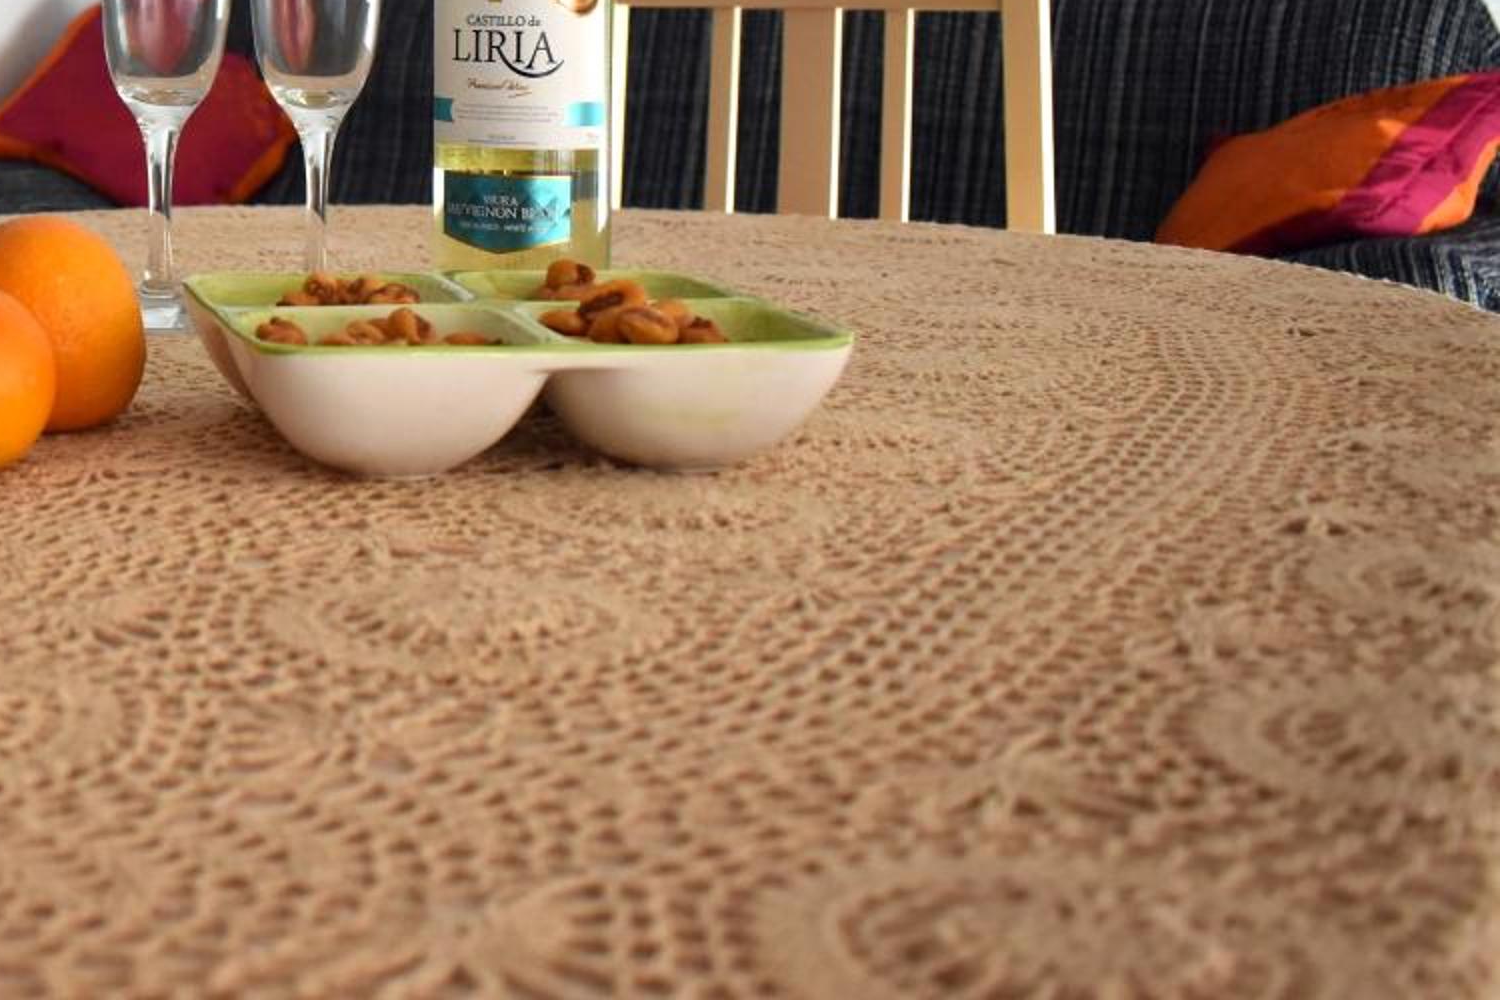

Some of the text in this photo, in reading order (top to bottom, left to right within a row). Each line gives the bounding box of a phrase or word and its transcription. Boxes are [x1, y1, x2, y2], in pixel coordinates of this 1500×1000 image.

[467, 14, 541, 27] CASTILLO de
[452, 28, 564, 78] LIRIA
